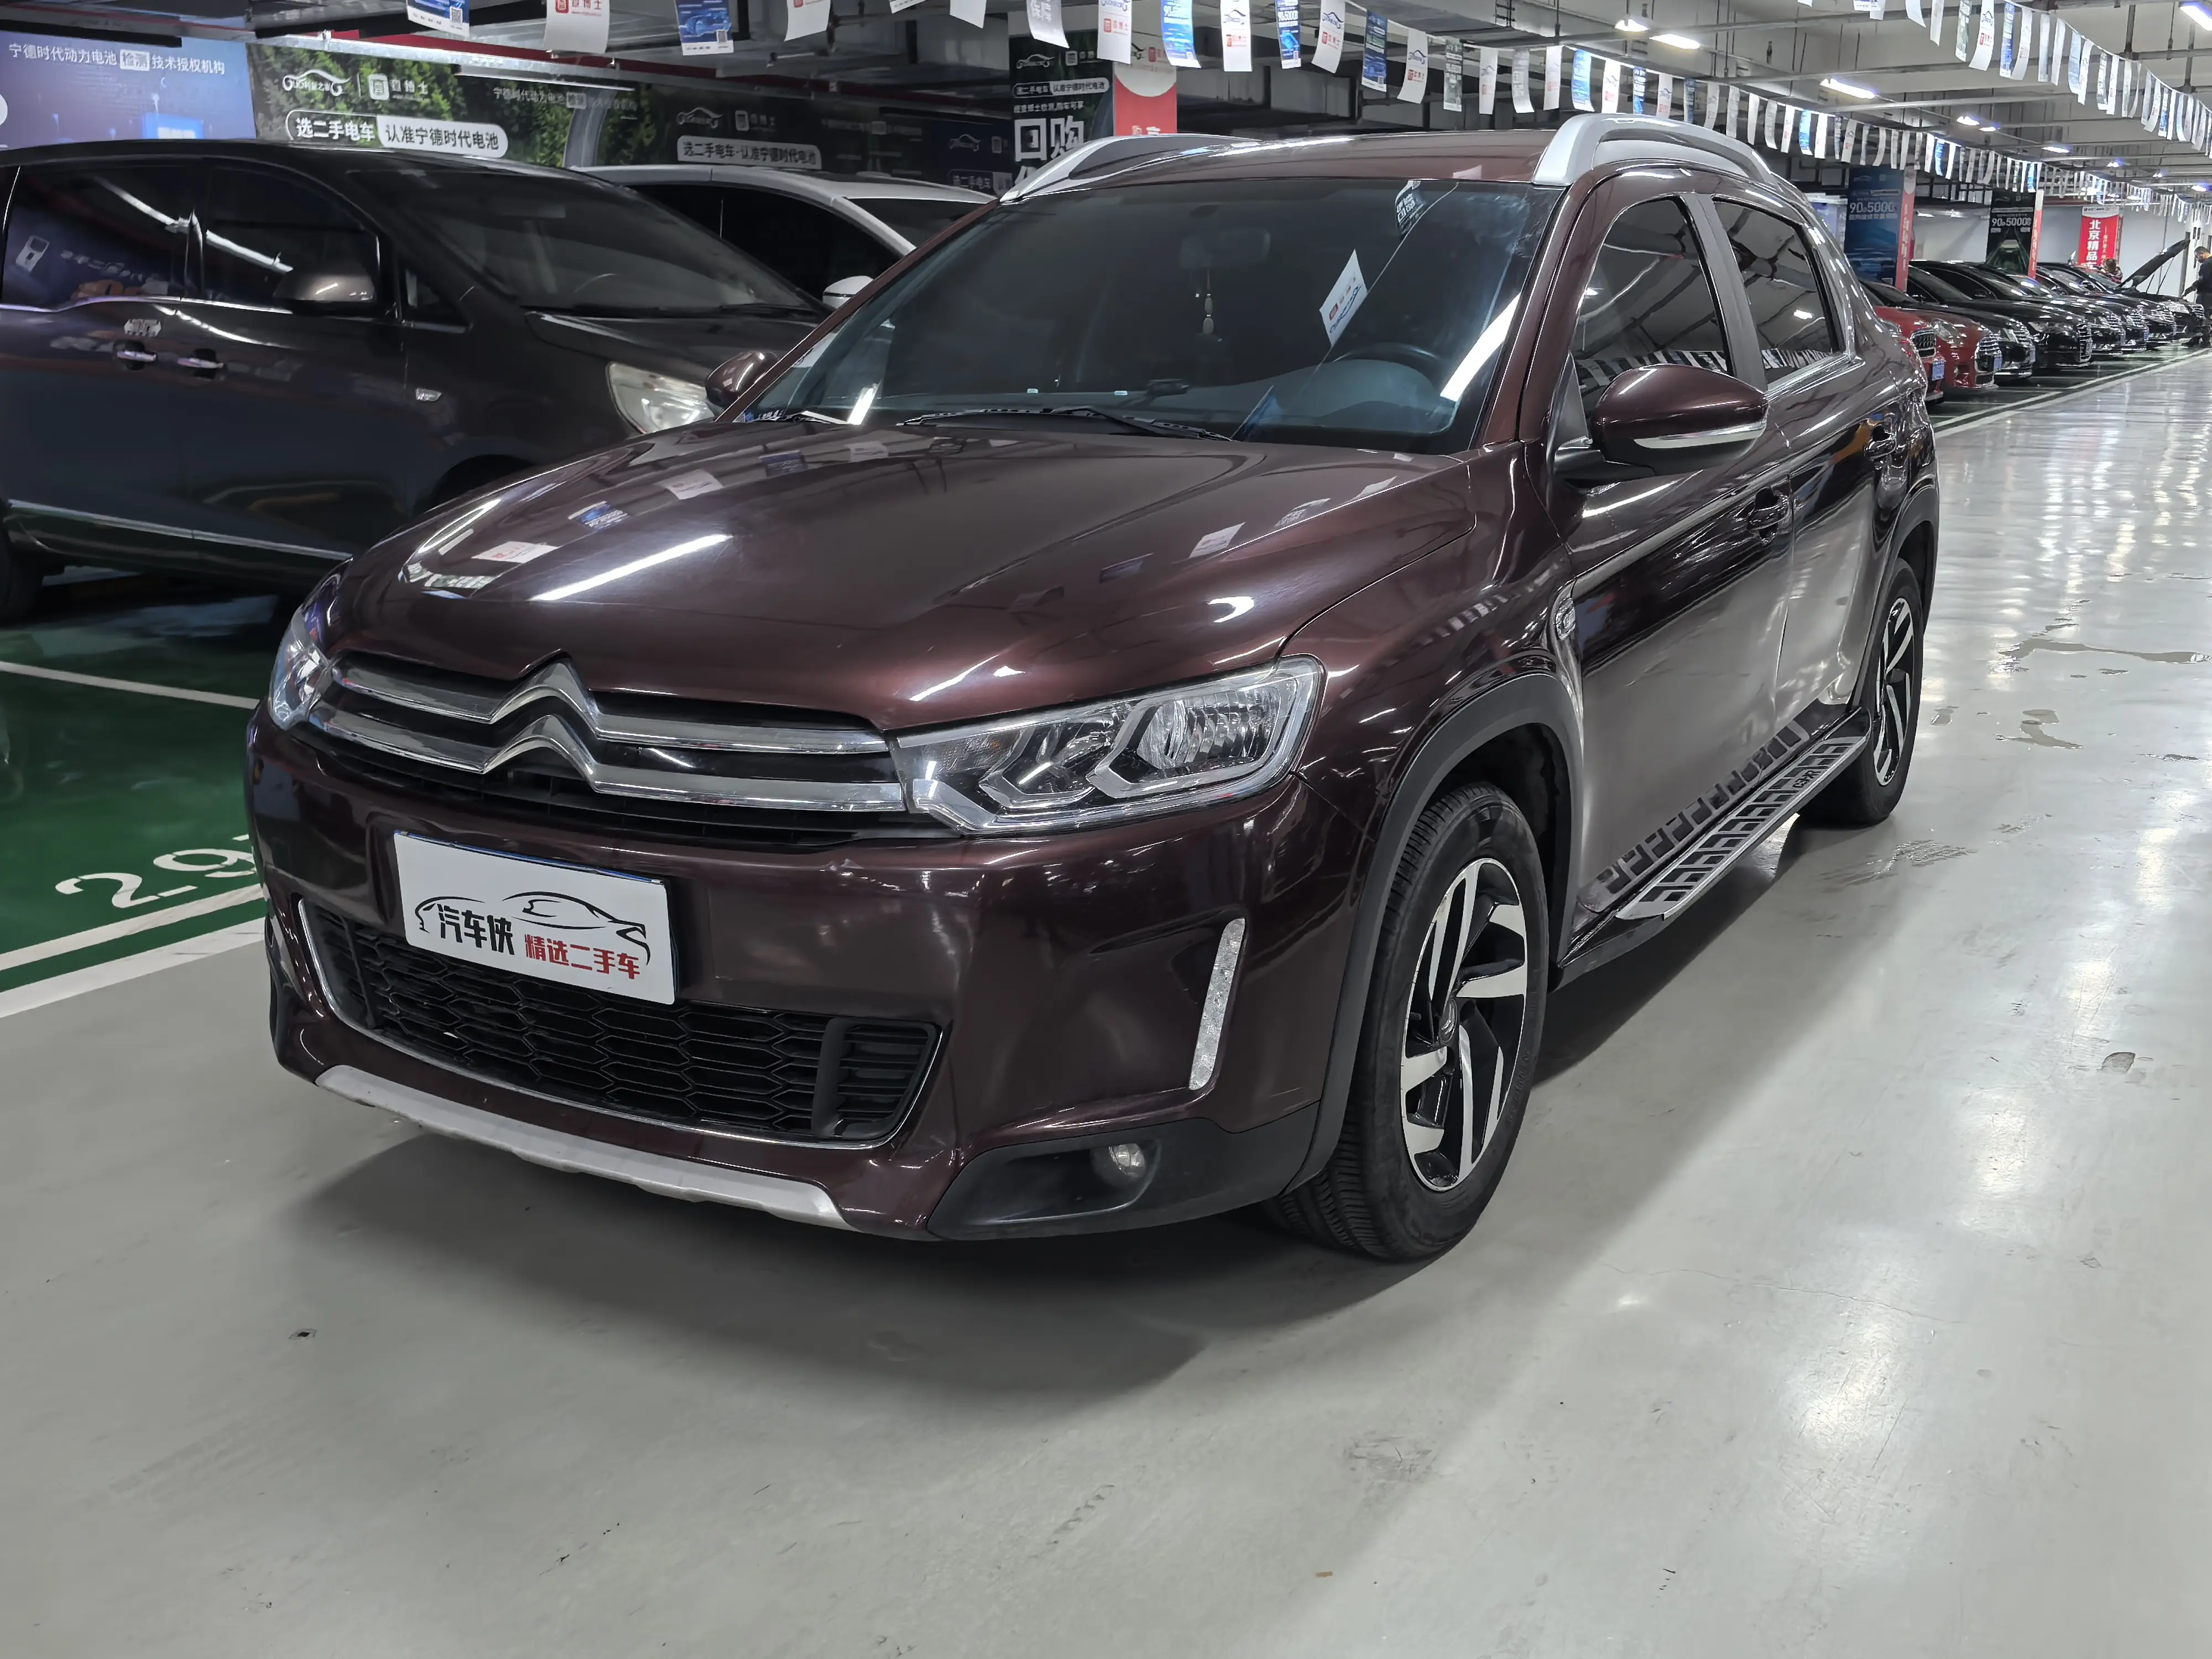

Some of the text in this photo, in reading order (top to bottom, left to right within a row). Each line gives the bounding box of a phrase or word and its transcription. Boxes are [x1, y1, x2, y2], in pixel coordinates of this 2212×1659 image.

[295, 117, 499, 150] 选二手电车 认准宁德时代电池
[1014, 115, 1084, 162] 回购
[55, 834, 258, 909] 29
[437, 902, 641, 980] 汽车侠 精选二手车
